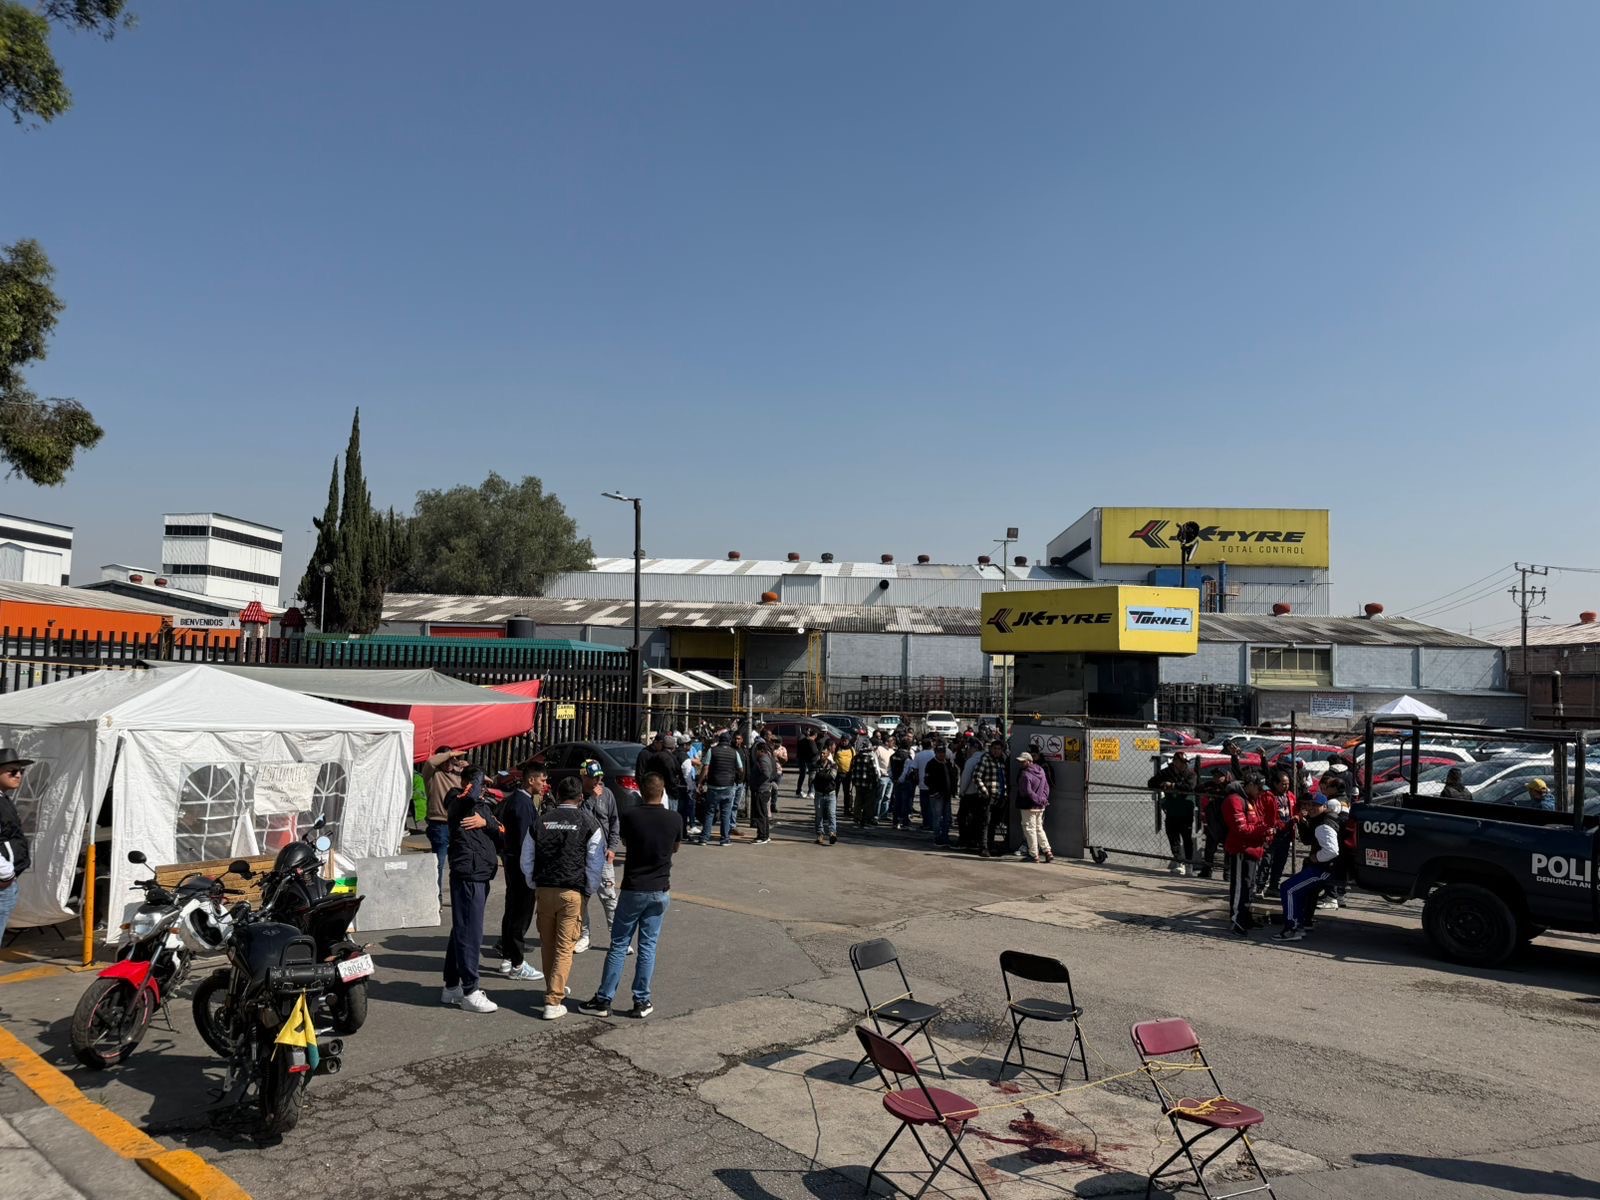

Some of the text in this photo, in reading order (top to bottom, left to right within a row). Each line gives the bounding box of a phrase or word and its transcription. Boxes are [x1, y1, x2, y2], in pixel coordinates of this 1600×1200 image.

[1222, 545, 1305, 555] TOTAL CONTROL
[180, 618, 236, 627] BIENVENIDOS A
[1129, 610, 1190, 626] TORNEL
[1363, 820, 1406, 836] 06295
[1531, 853, 1600, 882] POLI
[1536, 876, 1578, 887] DENUNCIA
